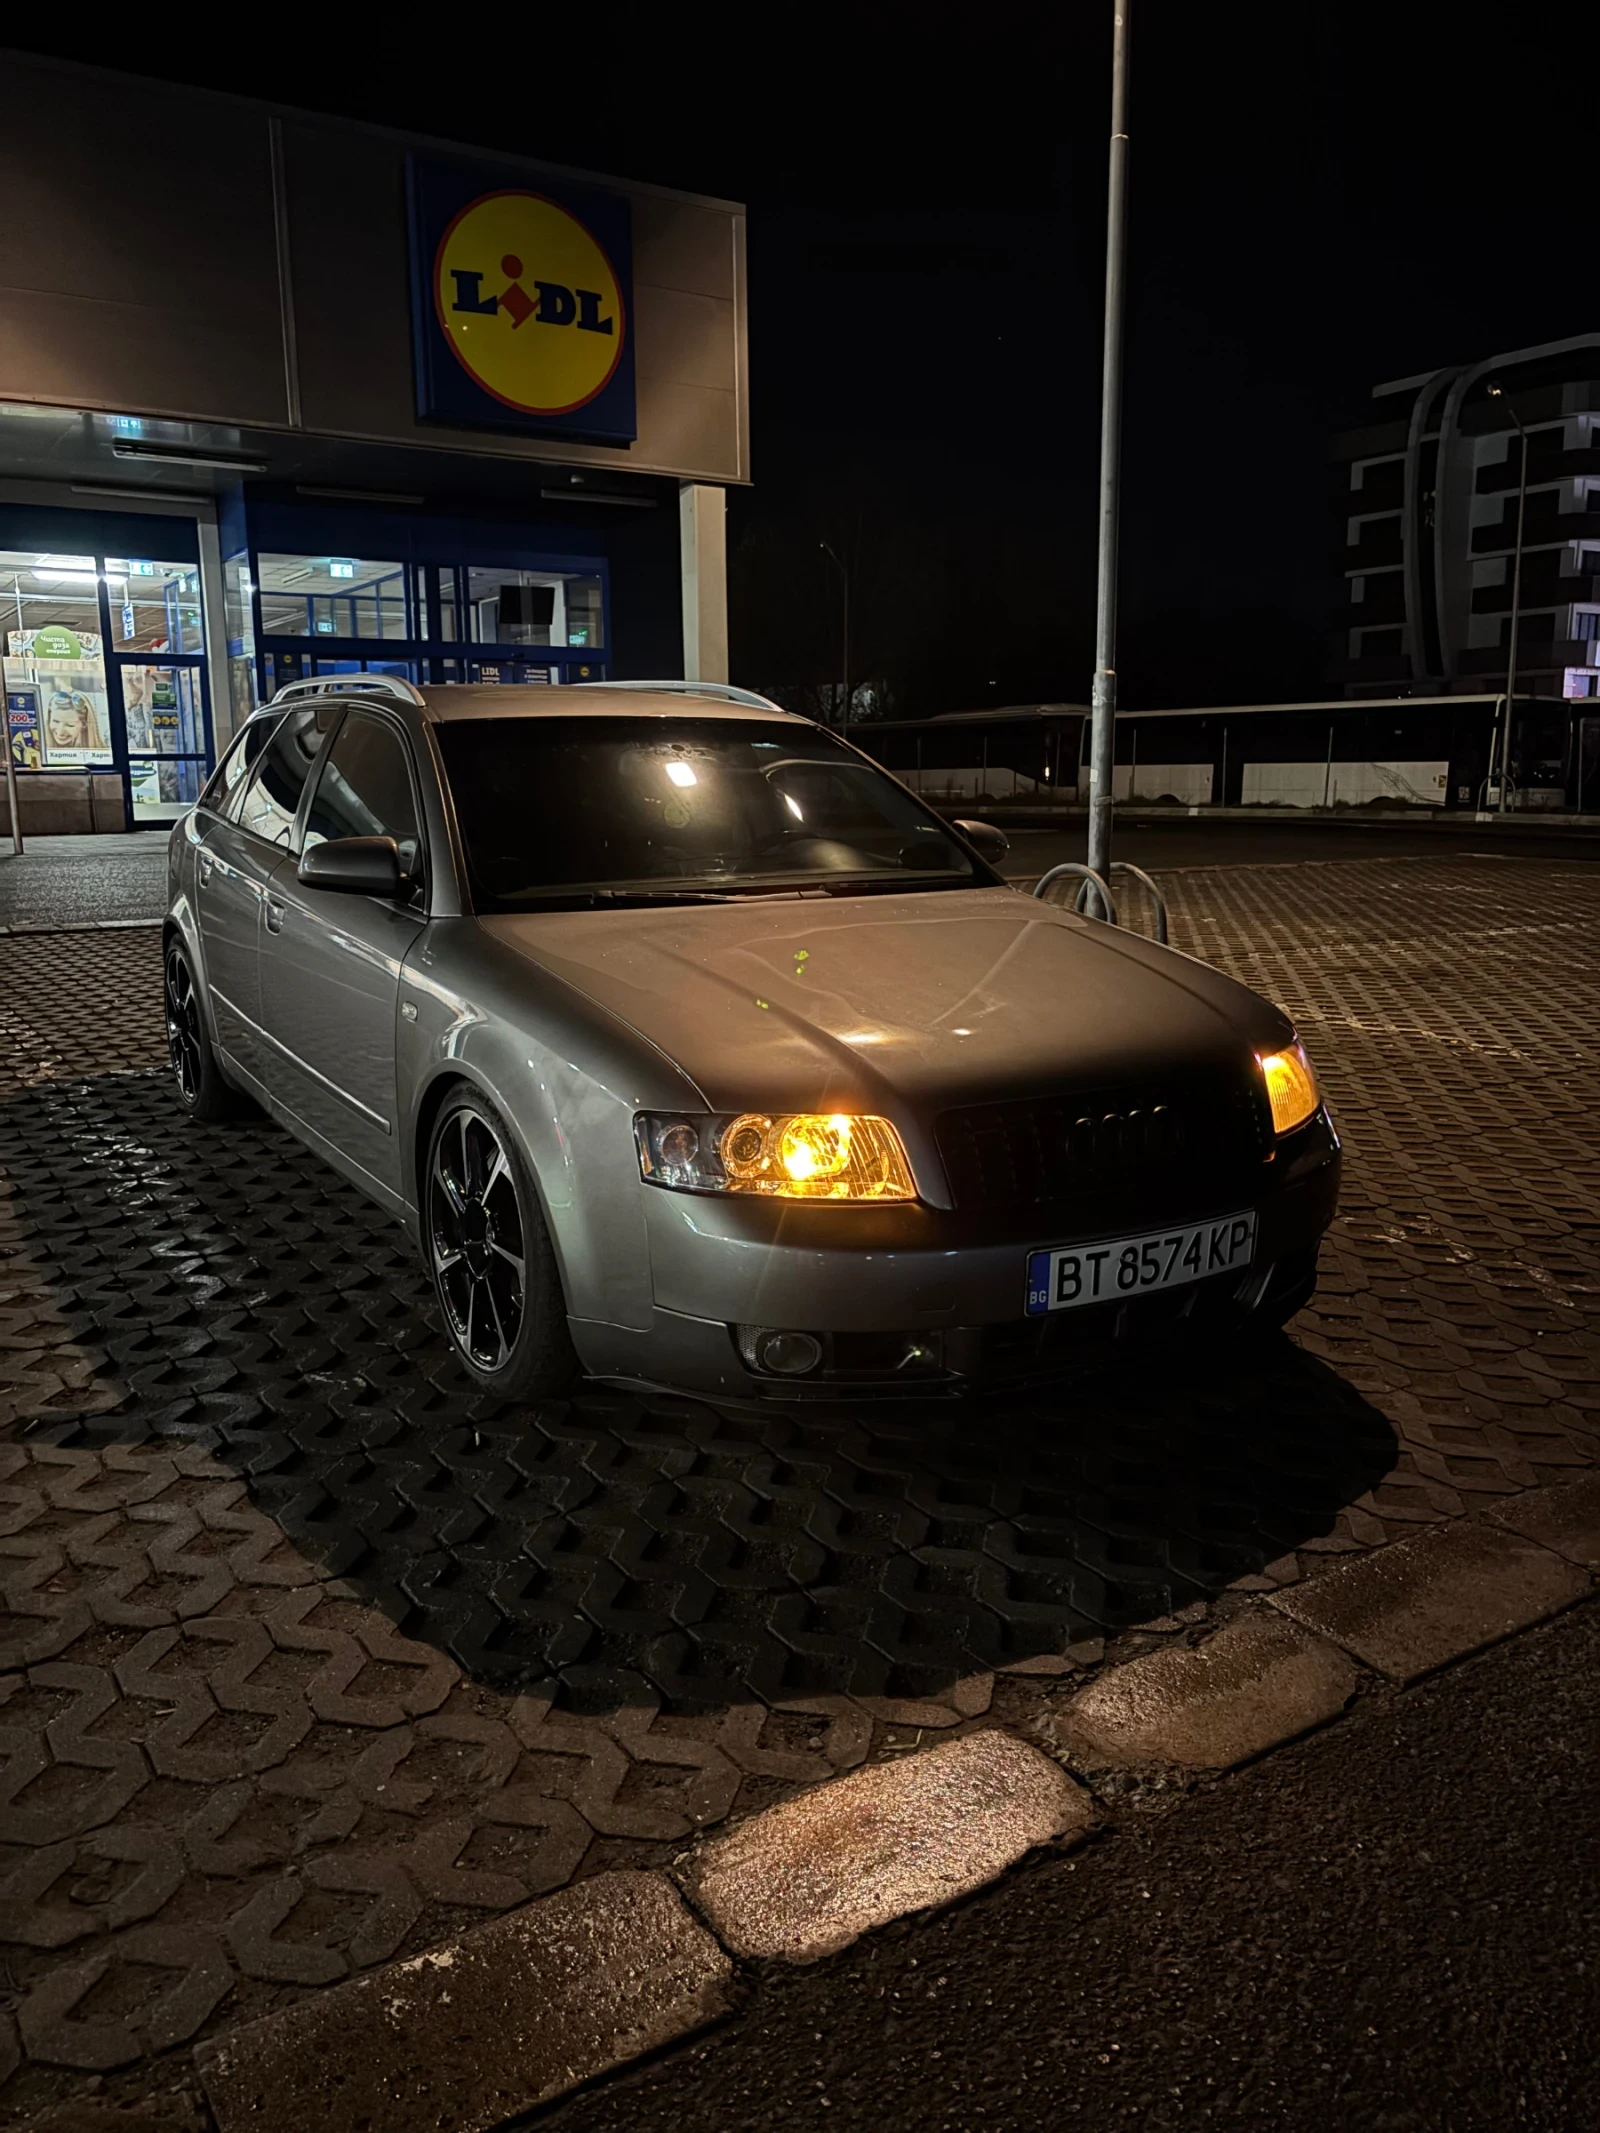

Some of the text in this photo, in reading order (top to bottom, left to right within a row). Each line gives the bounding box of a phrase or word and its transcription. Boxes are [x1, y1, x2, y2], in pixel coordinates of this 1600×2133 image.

[450, 254, 613, 336] LIDL
[40, 635, 65, 643] Чиста
[481, 667, 500, 676] LIDL
[10, 714, 28, 722] 200
[1056, 1219, 1249, 1302] BT 8574 KP
[1029, 1290, 1047, 1305] BG
